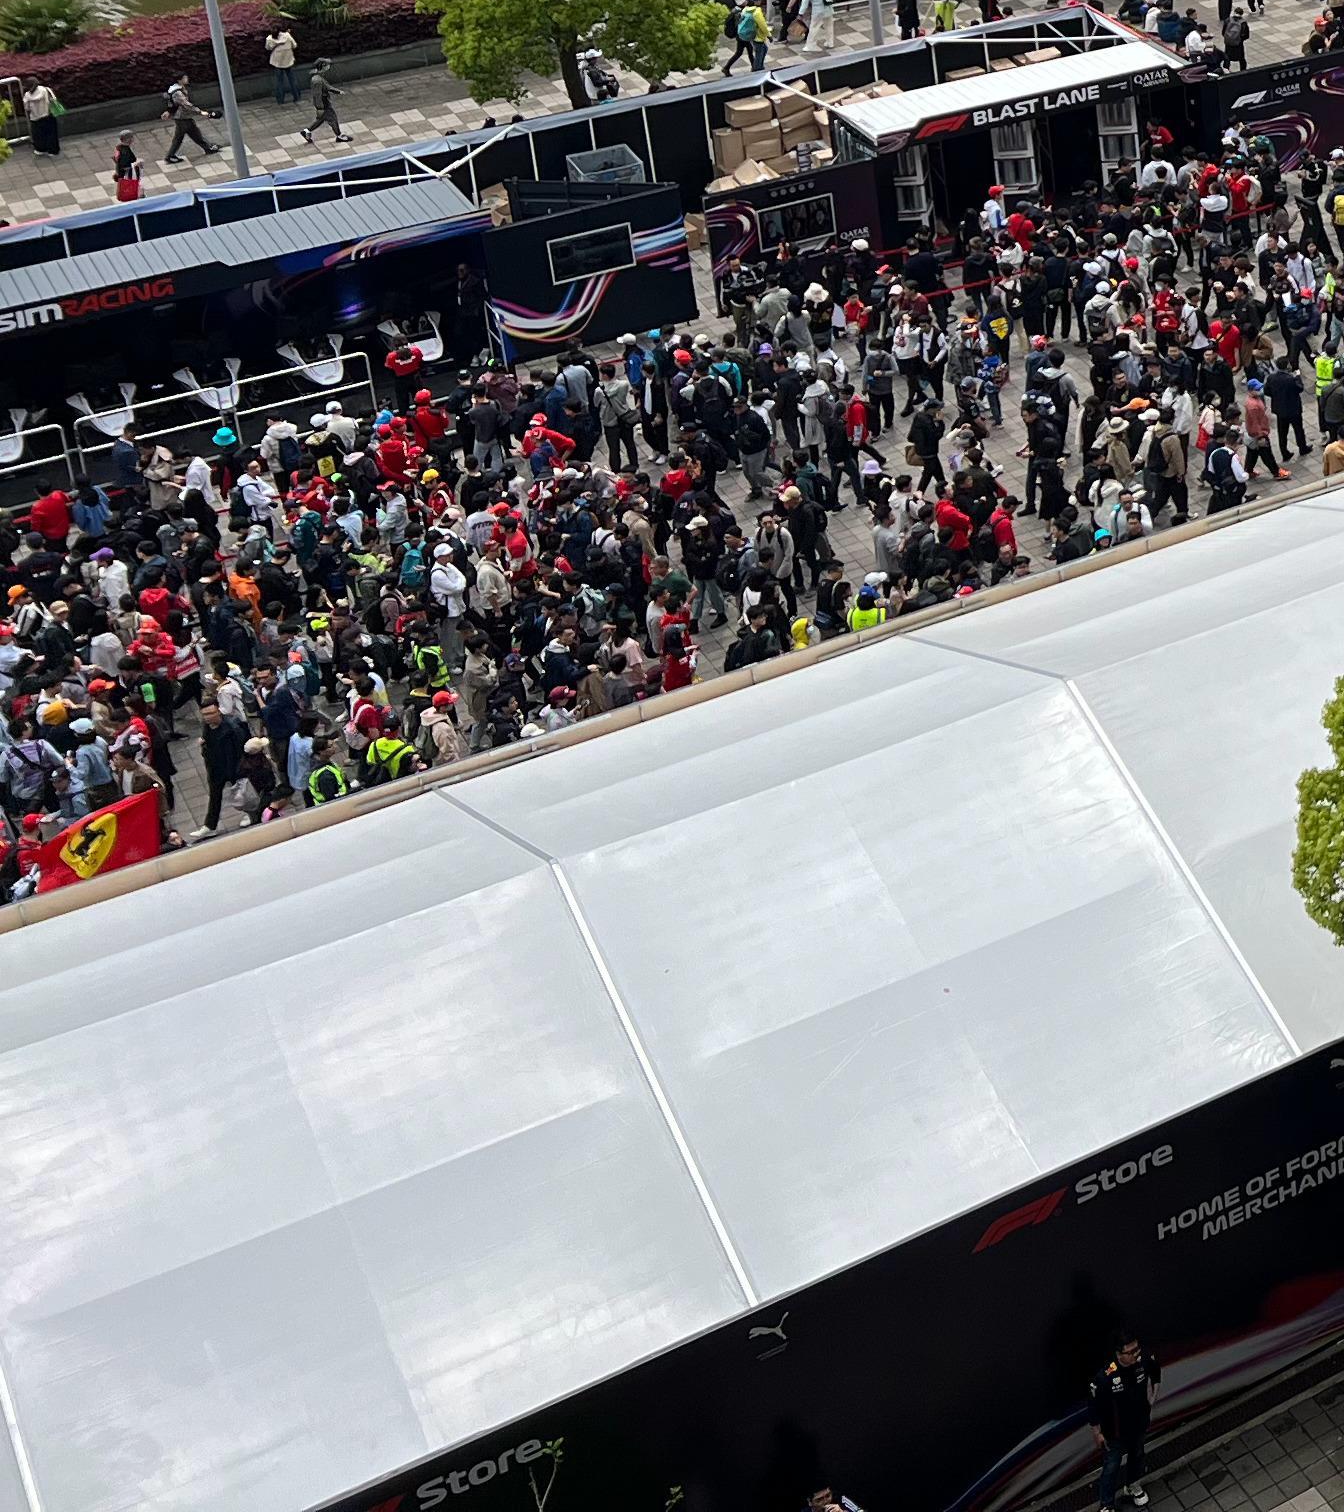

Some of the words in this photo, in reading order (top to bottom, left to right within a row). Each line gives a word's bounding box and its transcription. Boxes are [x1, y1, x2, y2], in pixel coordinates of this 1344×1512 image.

[1133, 67, 1169, 85] QATAR
[1274, 82, 1300, 95] QATAR
[972, 97, 1040, 127] BLAST
[1043, 84, 1100, 110] LANE
[839, 226, 870, 240] QATAR
[60, 277, 175, 317] RACING
[1075, 1143, 1174, 1205] Store
[1157, 1186, 1241, 1241] HOME
[1246, 1167, 1281, 1197] OF
[416, 1438, 546, 1512] Store
